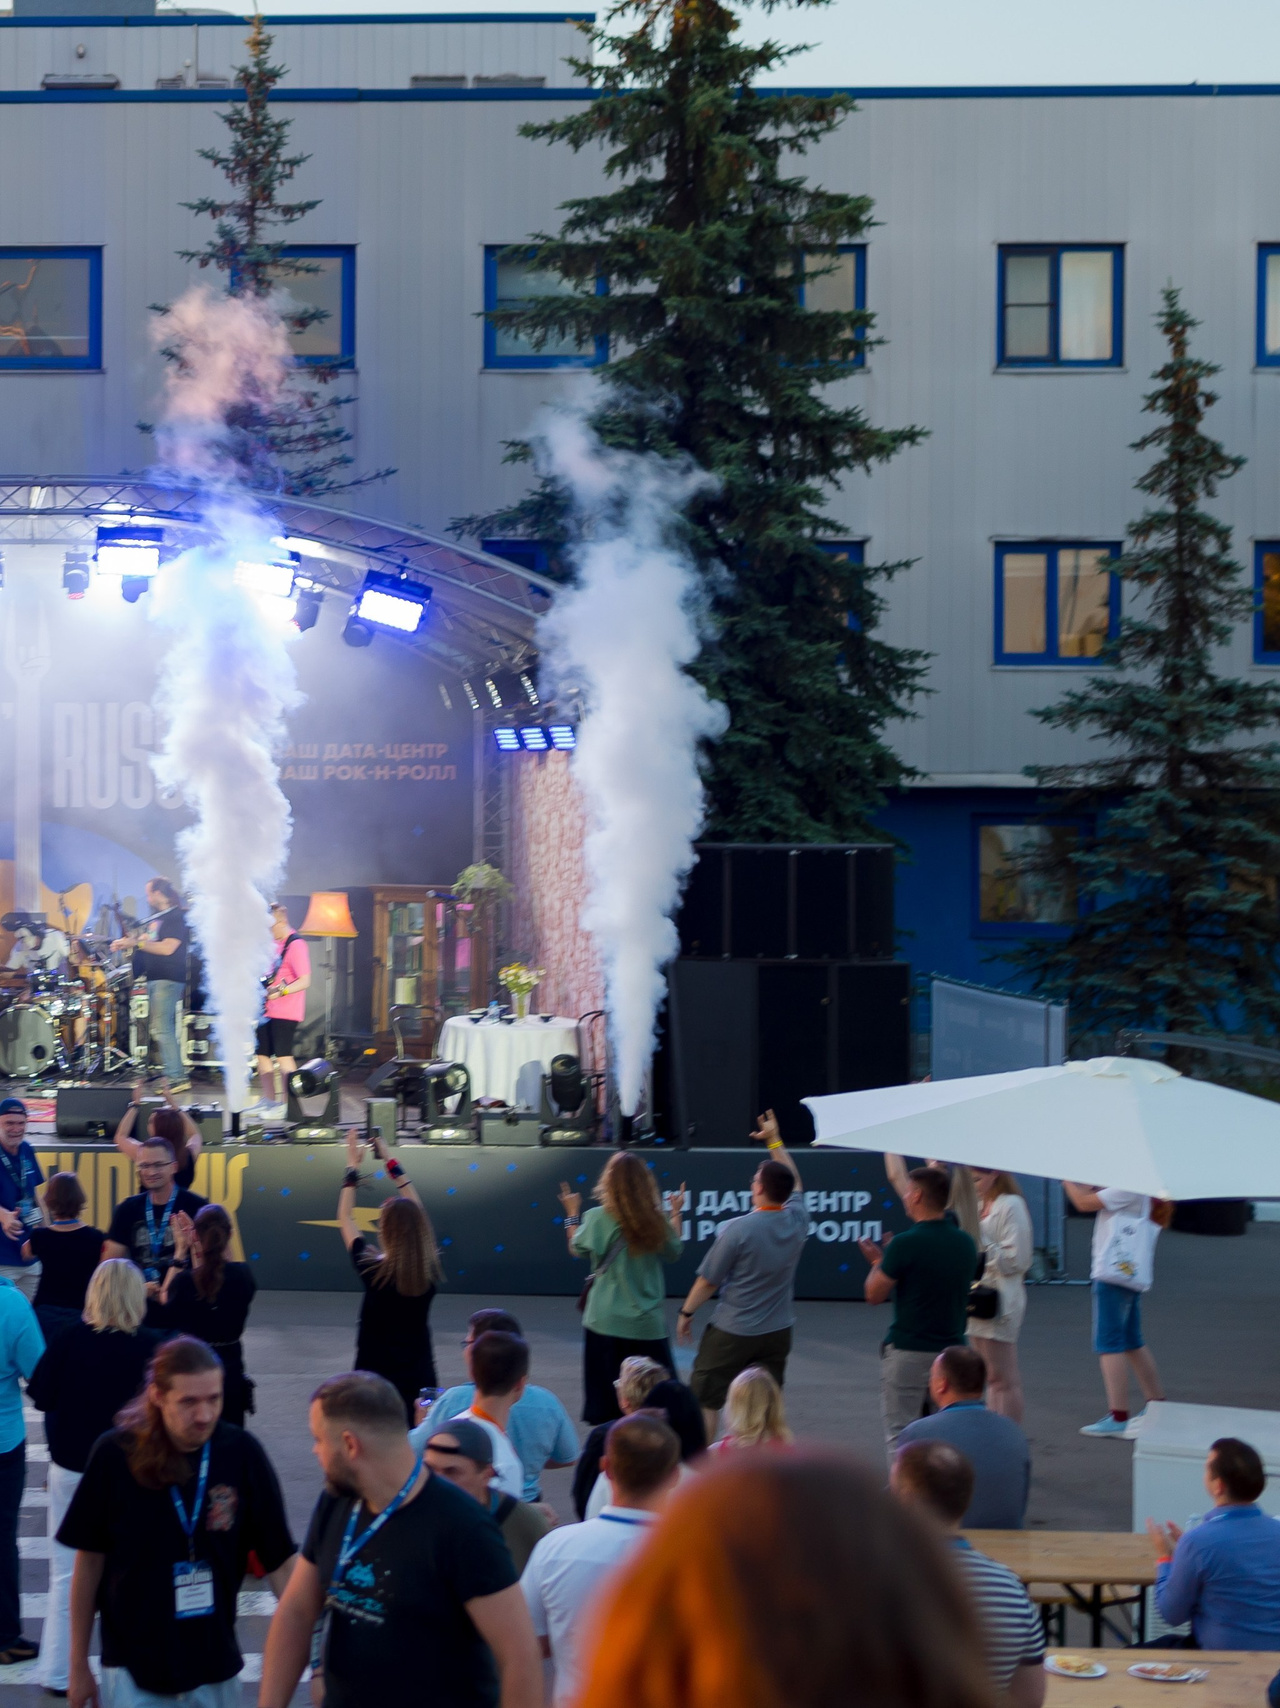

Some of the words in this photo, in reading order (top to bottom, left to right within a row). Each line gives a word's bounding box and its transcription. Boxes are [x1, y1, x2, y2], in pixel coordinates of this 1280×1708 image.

[322, 743, 449, 761] ДАТА-ЦЕНТР
[282, 765, 319, 780] АШ
[323, 765, 457, 780] РОК-Н-РОЛЛ
[695, 1190, 872, 1216] ДАТЕНТР
